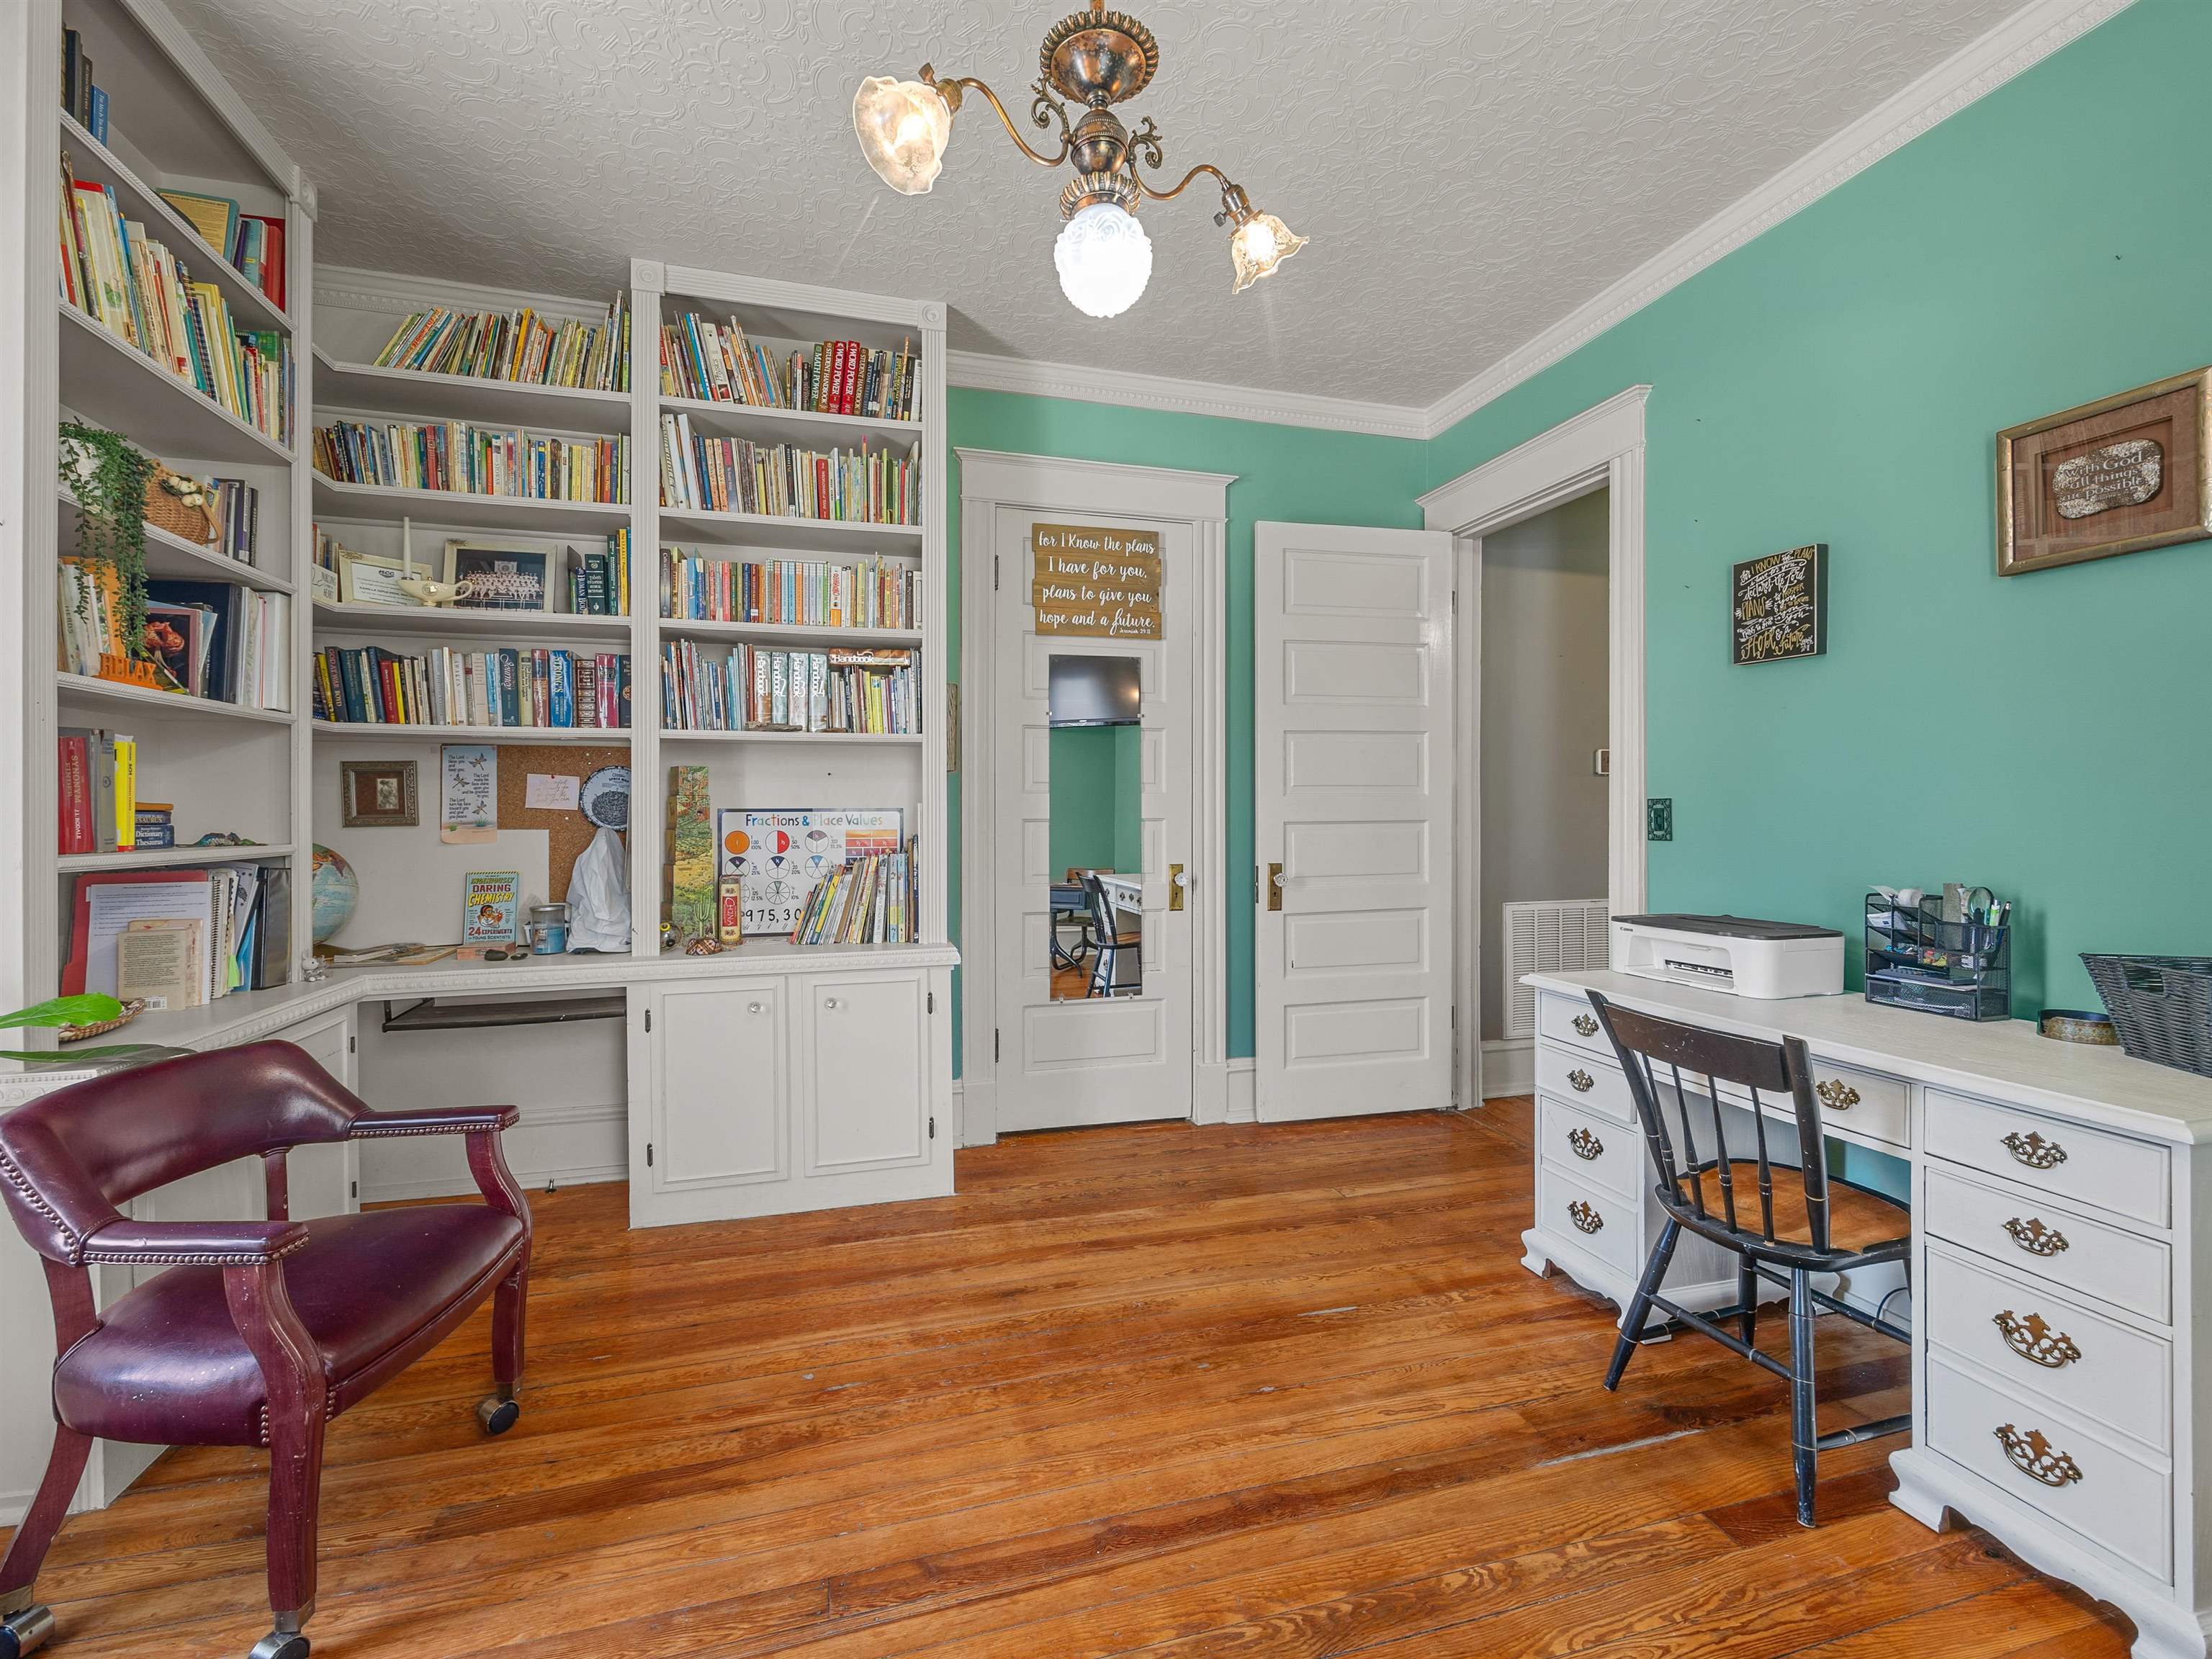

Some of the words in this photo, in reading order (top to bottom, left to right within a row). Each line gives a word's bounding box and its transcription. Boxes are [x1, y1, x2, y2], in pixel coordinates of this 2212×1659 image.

[835, 348, 844, 369] WORD
[848, 348, 857, 369] WORD
[811, 374, 821, 399] POWER
[832, 370, 842, 395] POWER
[845, 370, 855, 395] POWER
[2103, 451, 2143, 471] God
[2070, 475, 2088, 490] all
[2092, 468, 2139, 485] things
[1061, 532, 1066, 547] I
[1105, 536, 1123, 551] the
[1125, 539, 1155, 557] plans
[1048, 556, 1053, 572] I
[1058, 557, 1090, 574] have
[1093, 561, 1118, 580] for
[1755, 555, 1780, 574] KNOW
[1794, 547, 1815, 560] PLANS
[577, 575, 586, 598] HUMAN
[1043, 585, 1077, 603] plans
[1081, 585, 1096, 601] to
[1099, 588, 1125, 606] give
[1128, 593, 1152, 608] you
[1039, 609, 1069, 629] hope
[1071, 611, 1097, 626] and
[1100, 616, 1109, 626] a
[834, 654, 874, 663] Handbook
[554, 657, 563, 693] STRONG'S
[757, 657, 766, 697] Handbook
[773, 657, 783, 697] Handbook
[793, 658, 804, 697] Handbook
[812, 658, 821, 697] Handbook
[71, 755, 81, 804] SYNONYM
[746, 814, 799, 827] Fractions
[802, 816, 810, 826] &
[813, 815, 842, 827] Place
[845, 814, 883, 826] Values
[468, 892, 515, 907] CHEMISTRY
[472, 884, 511, 893] DARING
[468, 926, 482, 936] 24
